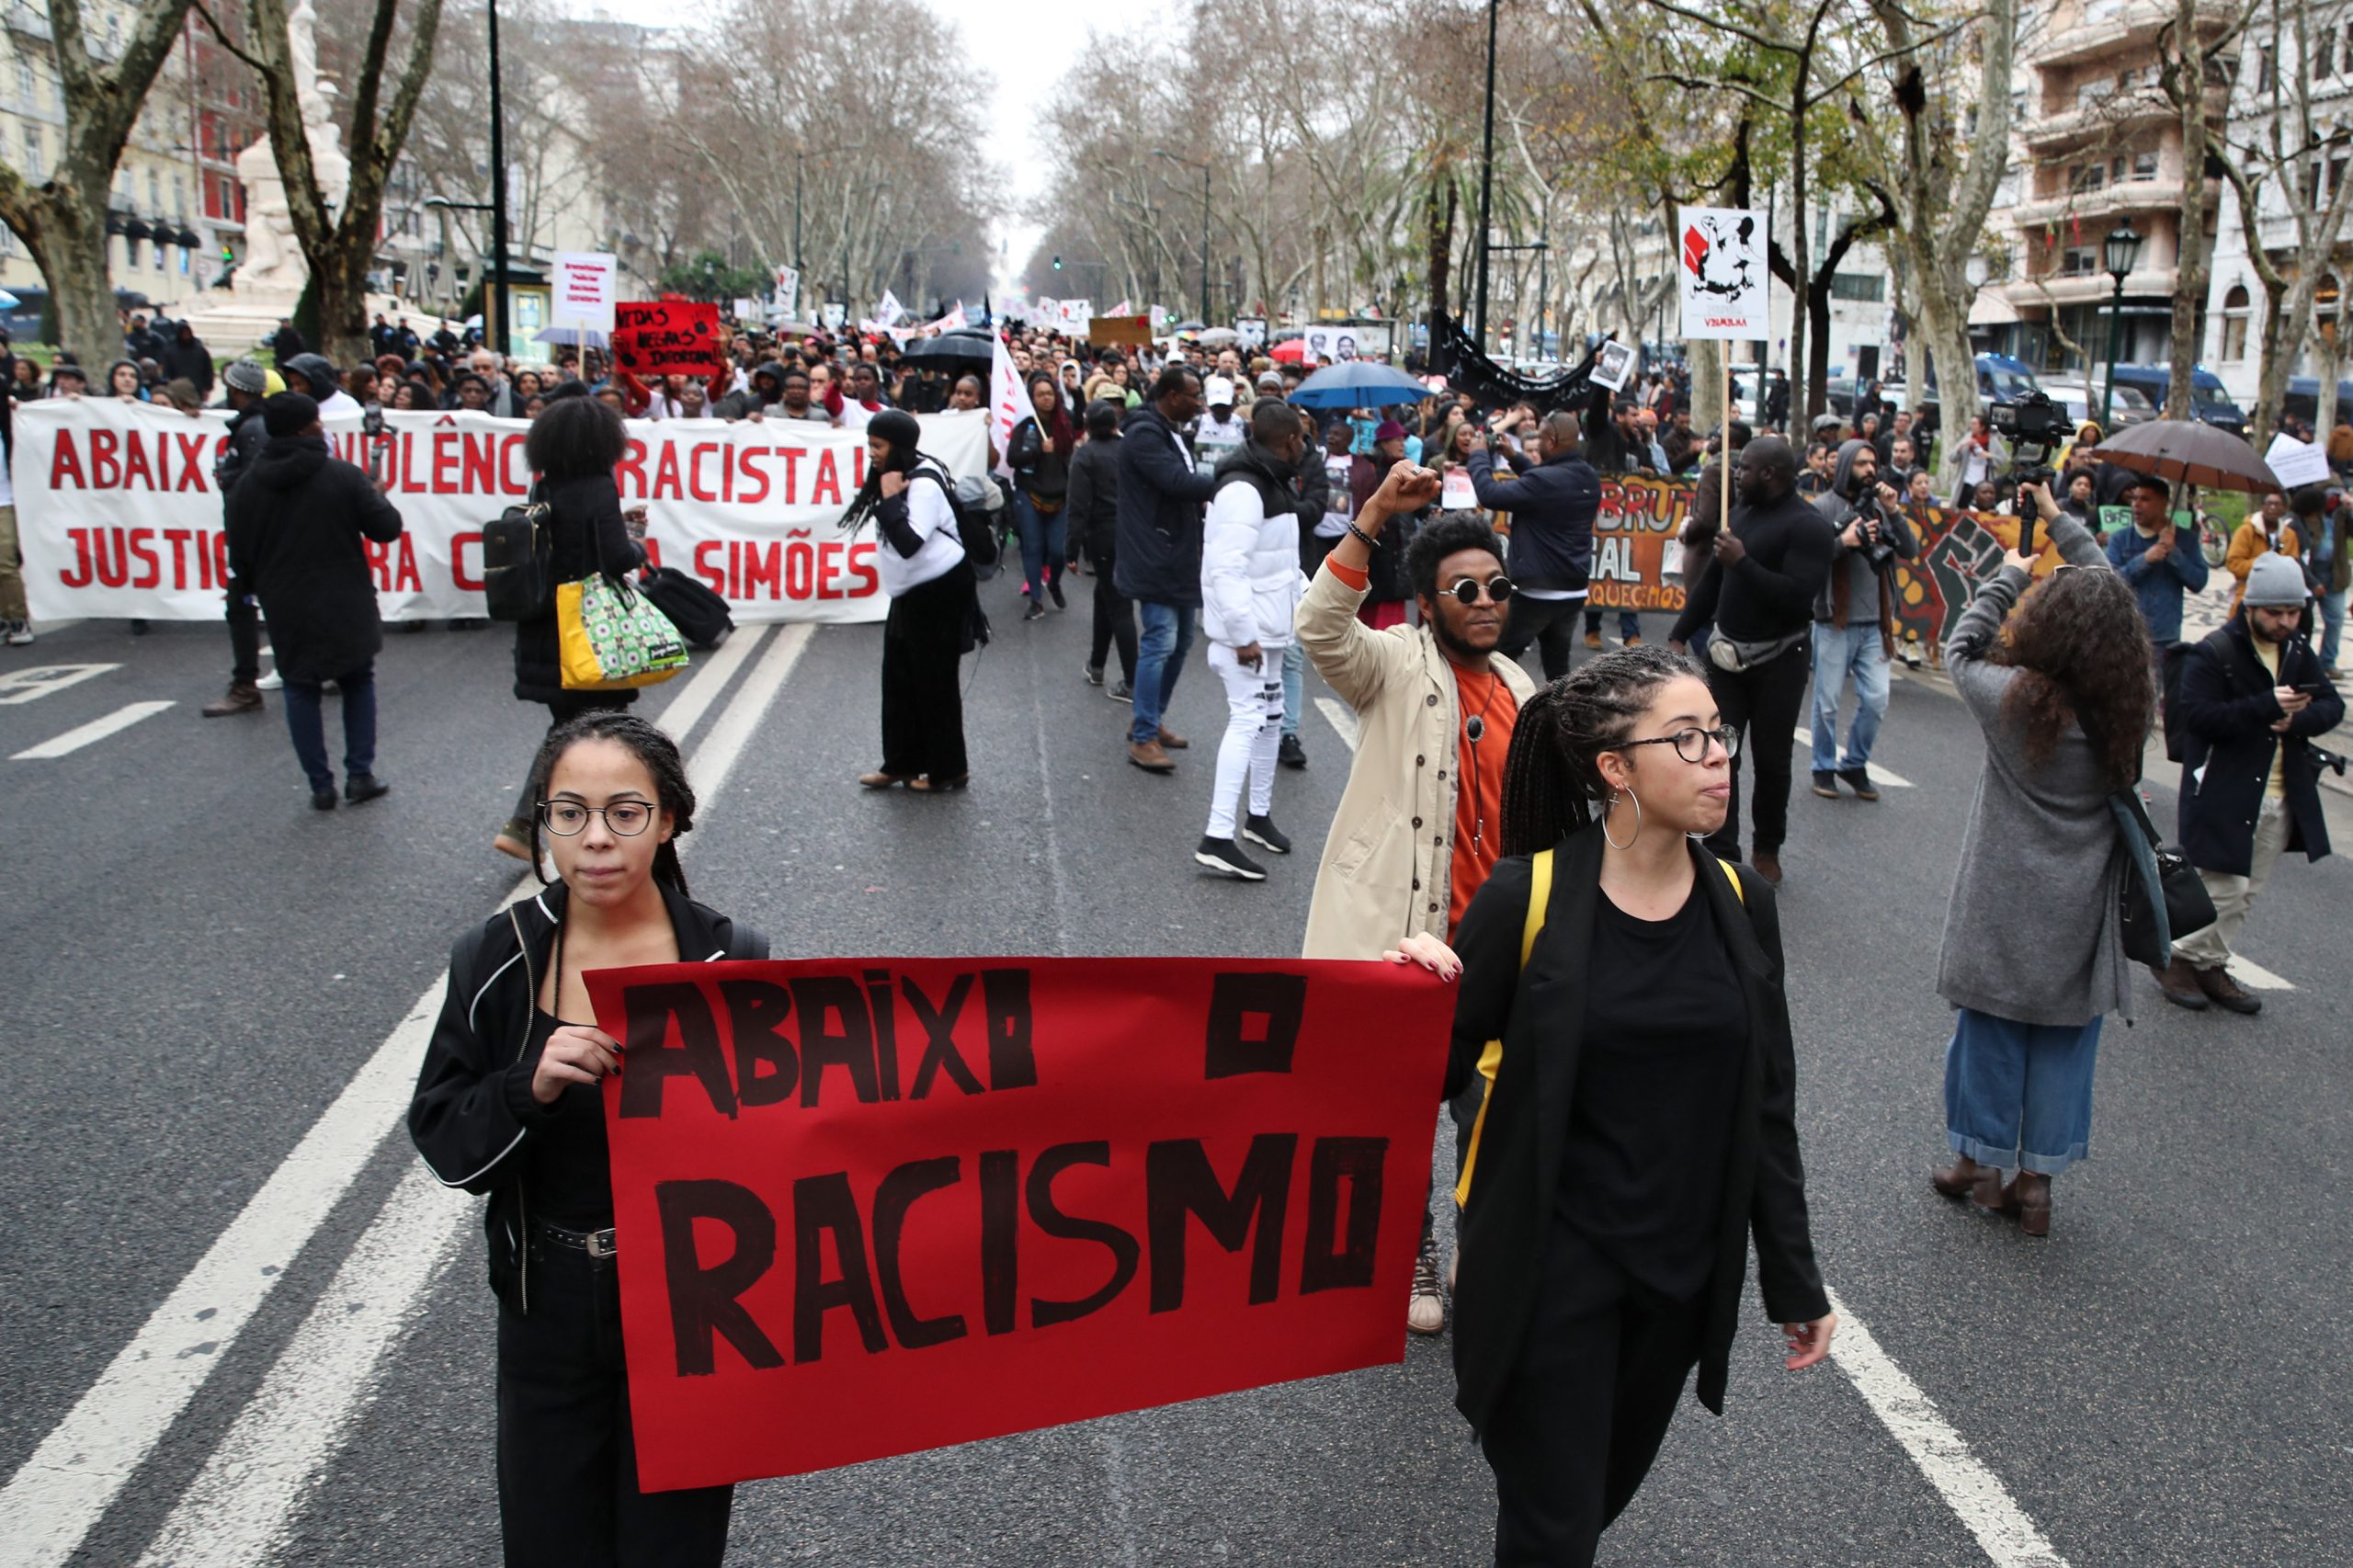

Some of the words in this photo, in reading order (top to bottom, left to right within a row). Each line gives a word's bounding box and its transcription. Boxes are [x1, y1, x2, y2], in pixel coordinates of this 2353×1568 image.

[616, 308, 669, 328] VIDAS
[693, 528, 881, 600] SIMÕES
[1204, 971, 1308, 1081] O
[654, 1131, 1390, 1378] RACISMO
